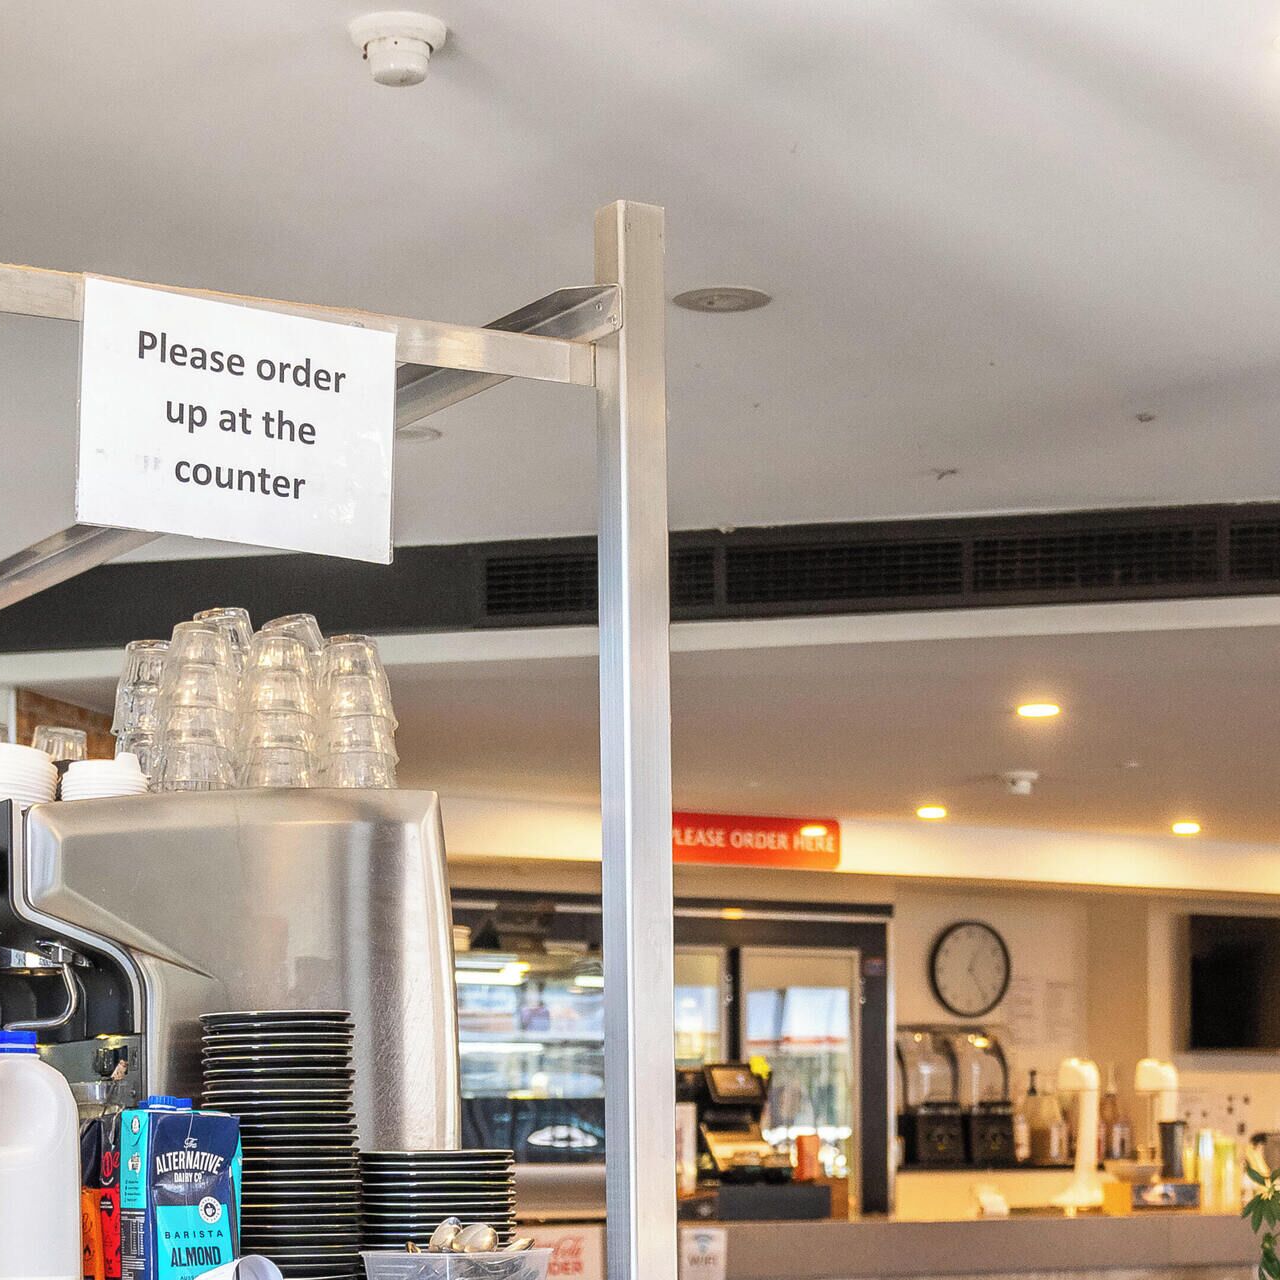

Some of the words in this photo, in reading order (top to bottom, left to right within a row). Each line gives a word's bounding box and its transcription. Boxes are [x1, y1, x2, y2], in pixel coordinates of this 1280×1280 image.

[138, 331, 245, 375] Please
[257, 358, 346, 393] order
[167, 400, 207, 433] up
[219, 408, 251, 434] at
[263, 411, 316, 445] the
[175, 460, 306, 499] counter
[730, 829, 788, 850] ORDER
[793, 832, 835, 853] HERE
[156, 1150, 224, 1175] ALTERNATIVE
[174, 1172, 193, 1183] DAIRY
[165, 1230, 224, 1239] BARISTA
[171, 1246, 222, 1268] ALMOND
